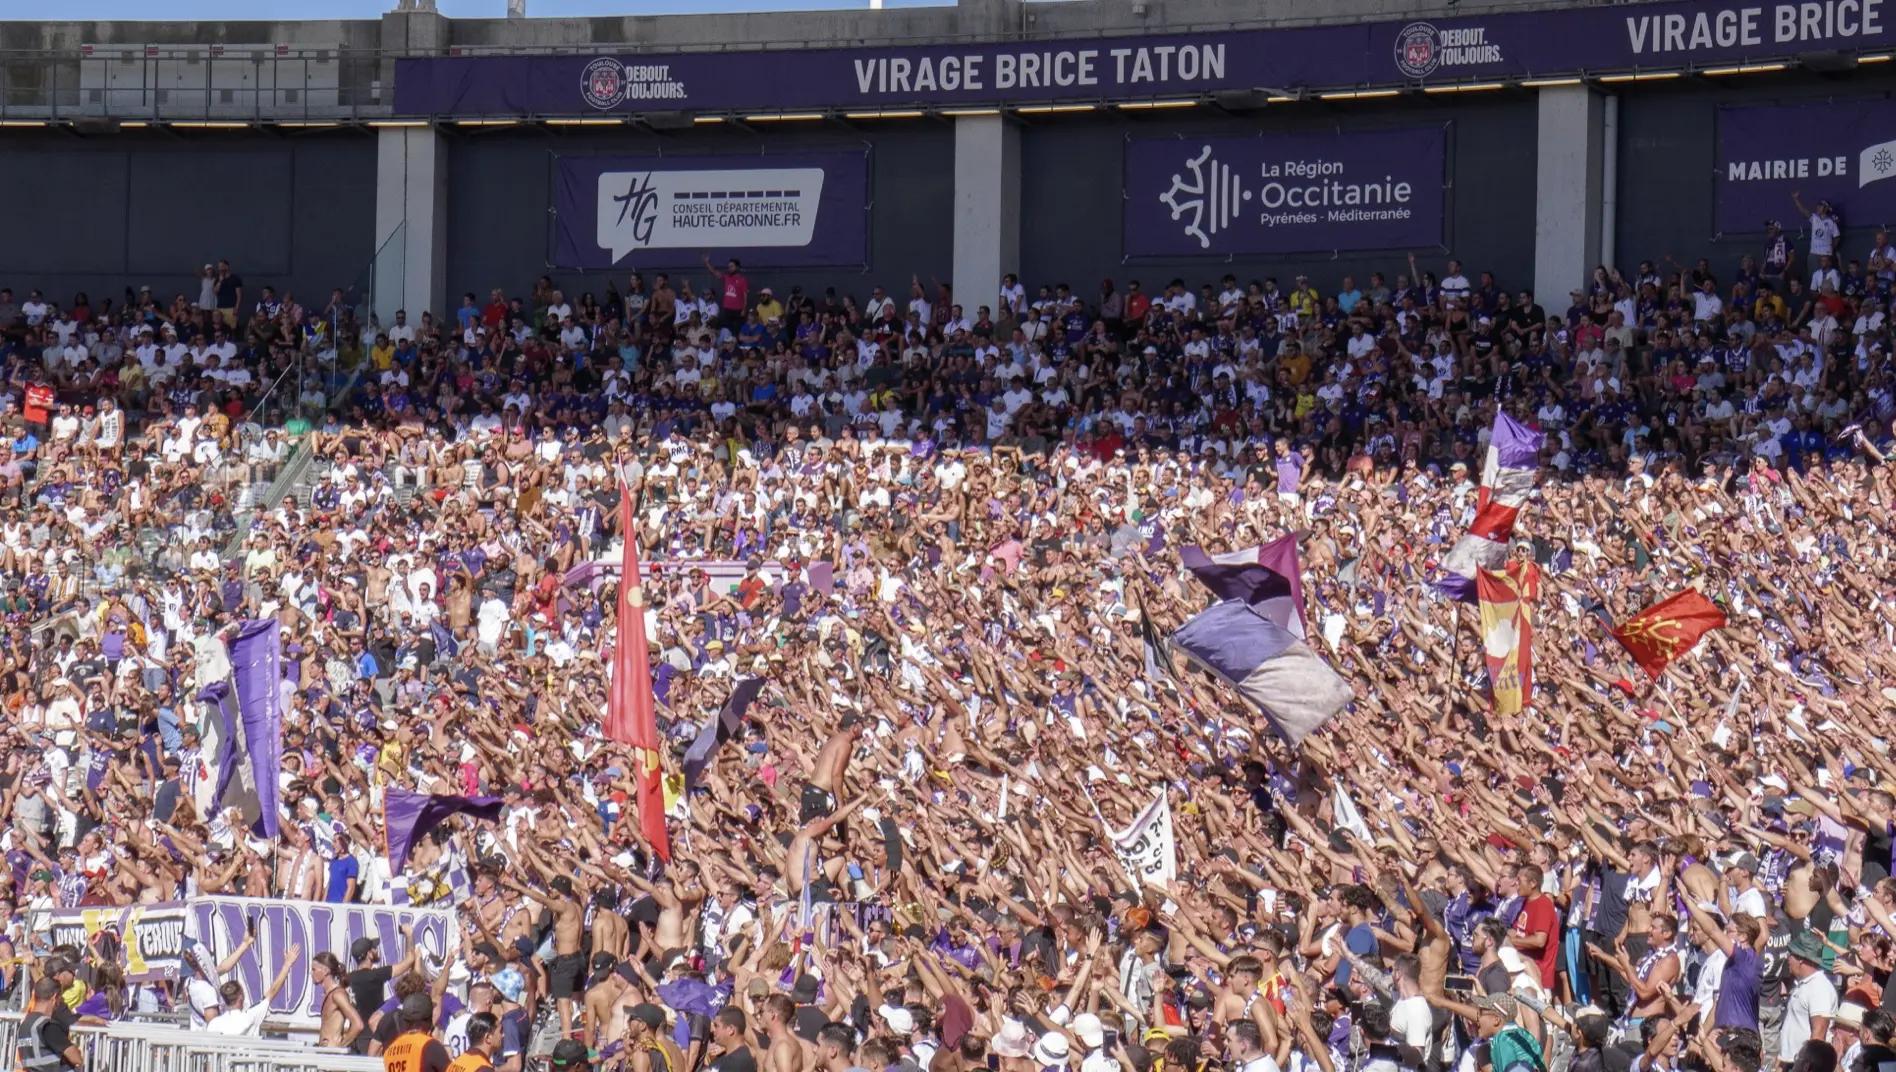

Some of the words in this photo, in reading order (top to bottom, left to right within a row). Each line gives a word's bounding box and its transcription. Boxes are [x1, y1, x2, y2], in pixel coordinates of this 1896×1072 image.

[1403, 25, 1436, 38] TOULOUSE
[1626, 8, 1762, 54] VIRAGE
[1774, 0, 1884, 43] BRICE
[1440, 28, 1488, 48] DEBOUT.
[1440, 45, 1504, 66] TOUJOURS.
[589, 60, 621, 72] TOULOUSE
[626, 65, 673, 82] DEBOUT.
[854, 55, 983, 94] VIRAGE
[995, 50, 1099, 89] BRICE
[1110, 44, 1226, 84] TATON
[626, 82, 688, 100] TOUJOURS.
[1261, 162, 1280, 178] La
[1284, 159, 1344, 179] Région
[1728, 158, 1809, 182] MAIRIE
[1817, 156, 1847, 177] DE
[1261, 175, 1412, 209] Occitanie
[613, 171, 659, 247] HG
[672, 203, 714, 214] CONSEIL
[716, 200, 800, 213] DÉPARTEMENTAL
[672, 213, 801, 229] HAUTE-GARONNE.FR
[1260, 211, 1317, 228] Pyrénées
[1327, 207, 1412, 223] Méditerranée
[450, 1034, 467, 1057] 31
